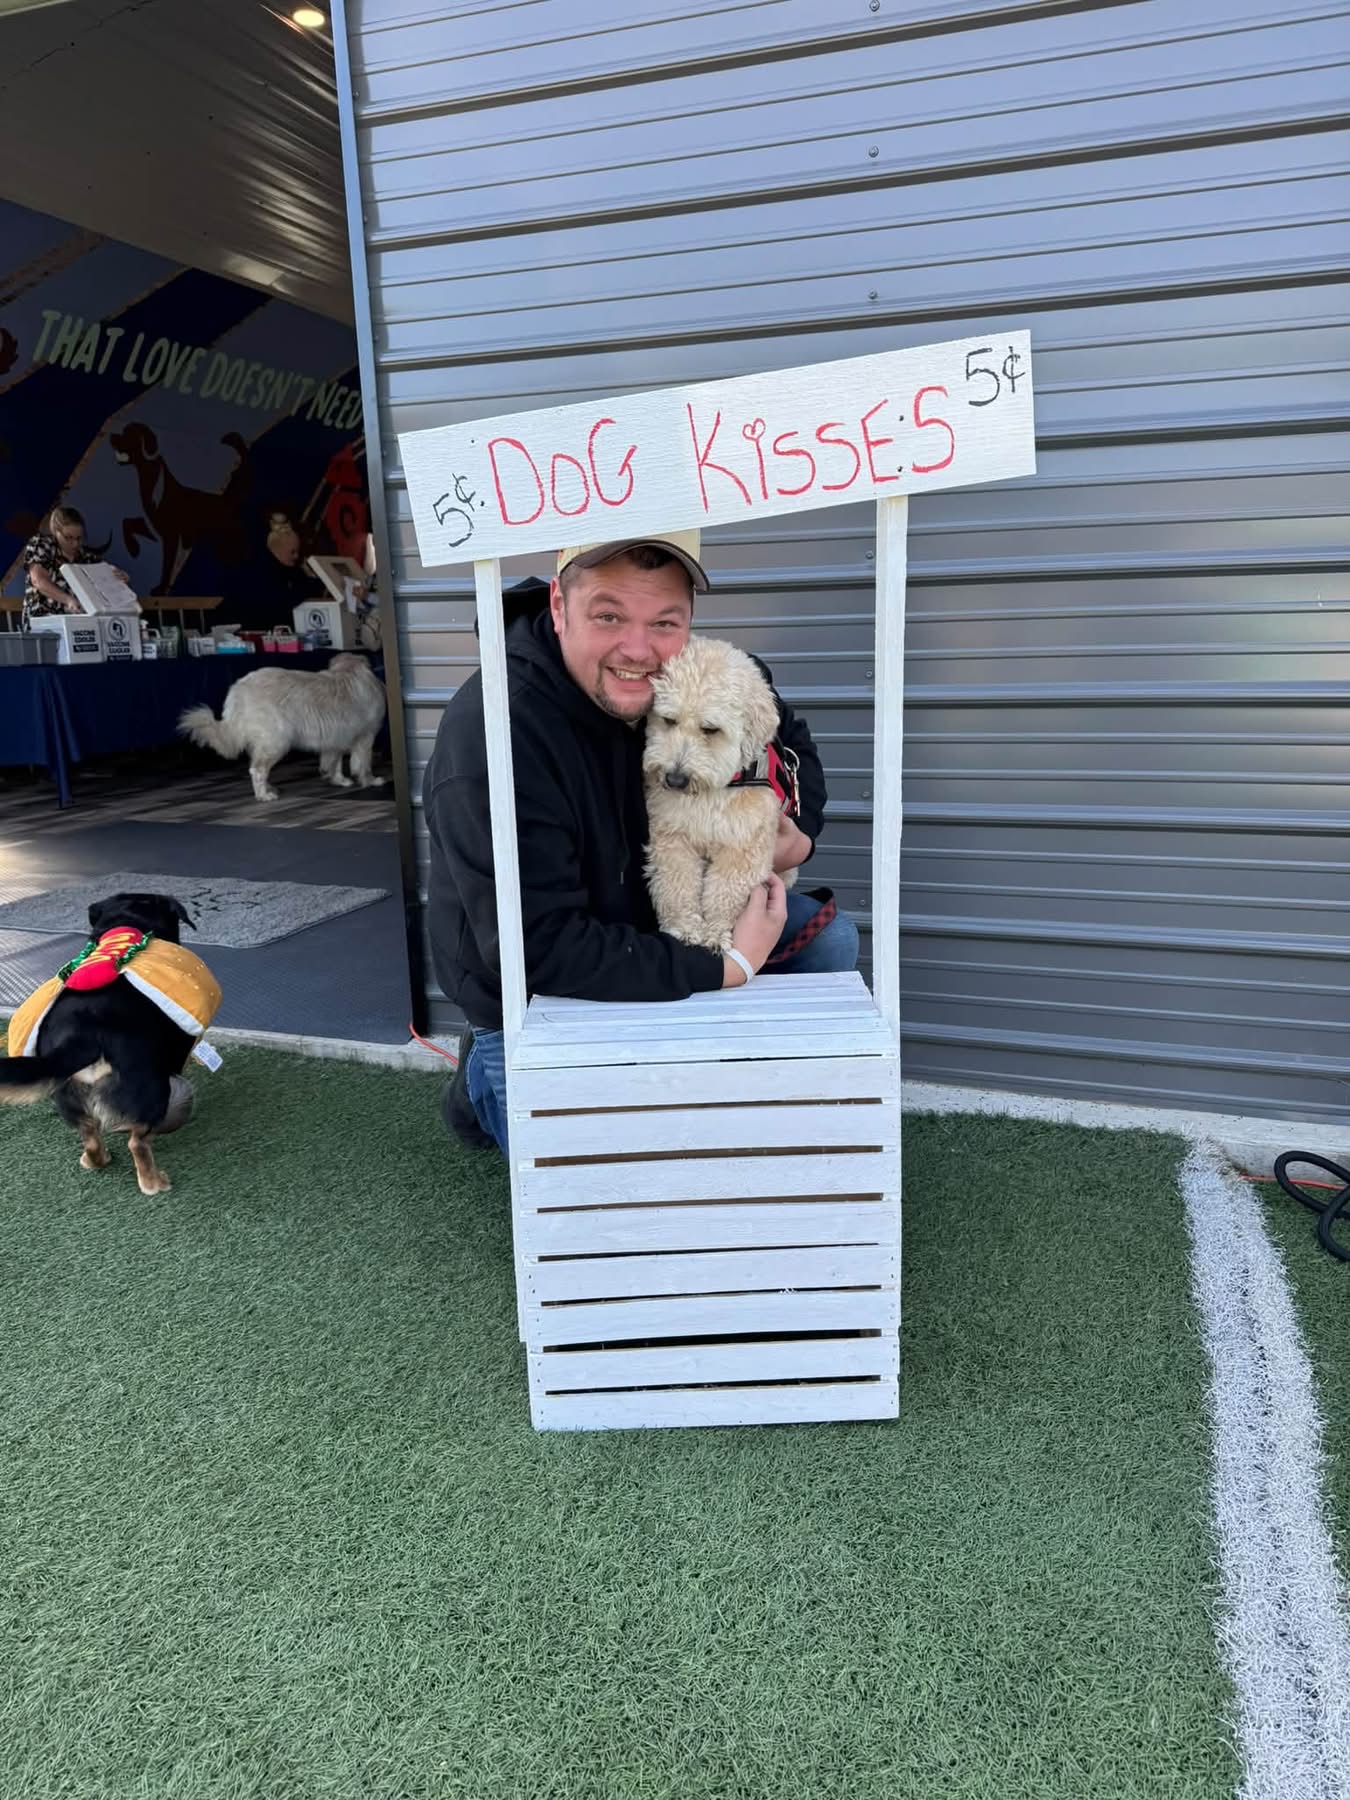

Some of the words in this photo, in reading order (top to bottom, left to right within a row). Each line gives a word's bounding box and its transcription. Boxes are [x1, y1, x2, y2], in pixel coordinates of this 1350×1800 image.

[32, 309, 124, 375] THAT
[123, 332, 207, 394] LOVE
[200, 353, 314, 416] DOESN'T
[305, 382, 363, 431] NEED
[964, 347, 1026, 406] 5¢
[488, 418, 637, 525] DOG
